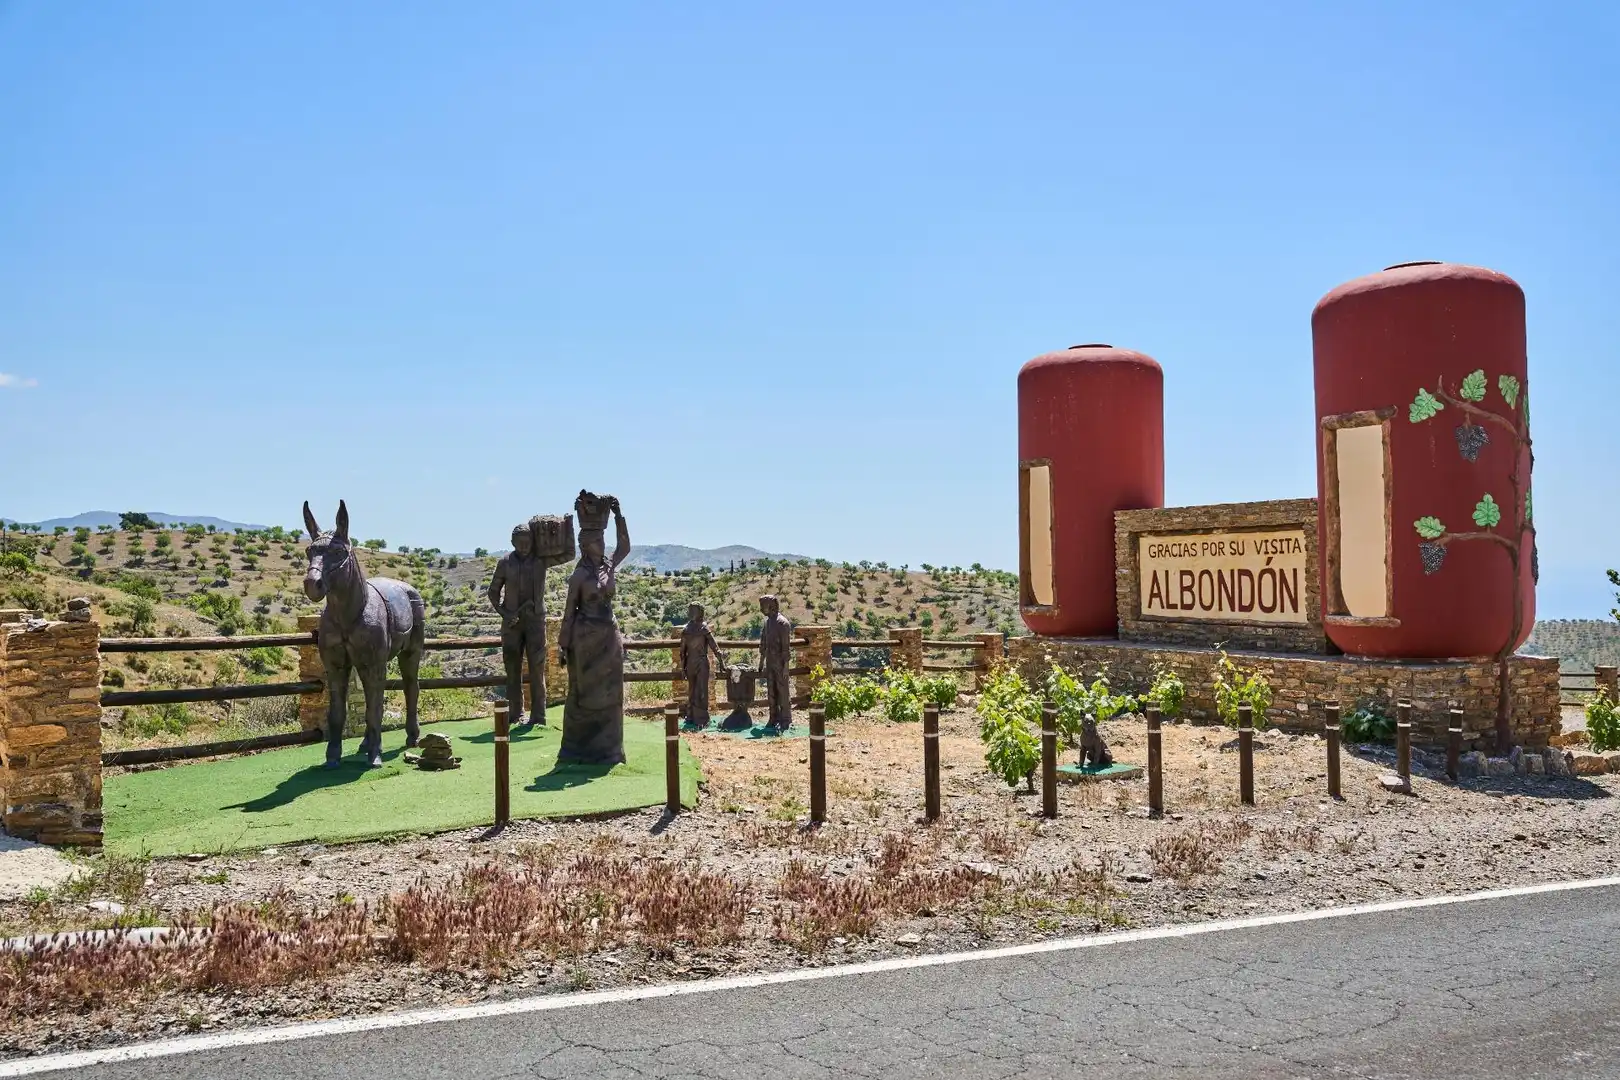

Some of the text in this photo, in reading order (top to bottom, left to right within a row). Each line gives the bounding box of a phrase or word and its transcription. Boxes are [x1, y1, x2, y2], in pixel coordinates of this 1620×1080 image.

[1148, 537, 1302, 558] GRACIAS POR SU VISITA
[1147, 556, 1299, 614] ALBONDÓN
